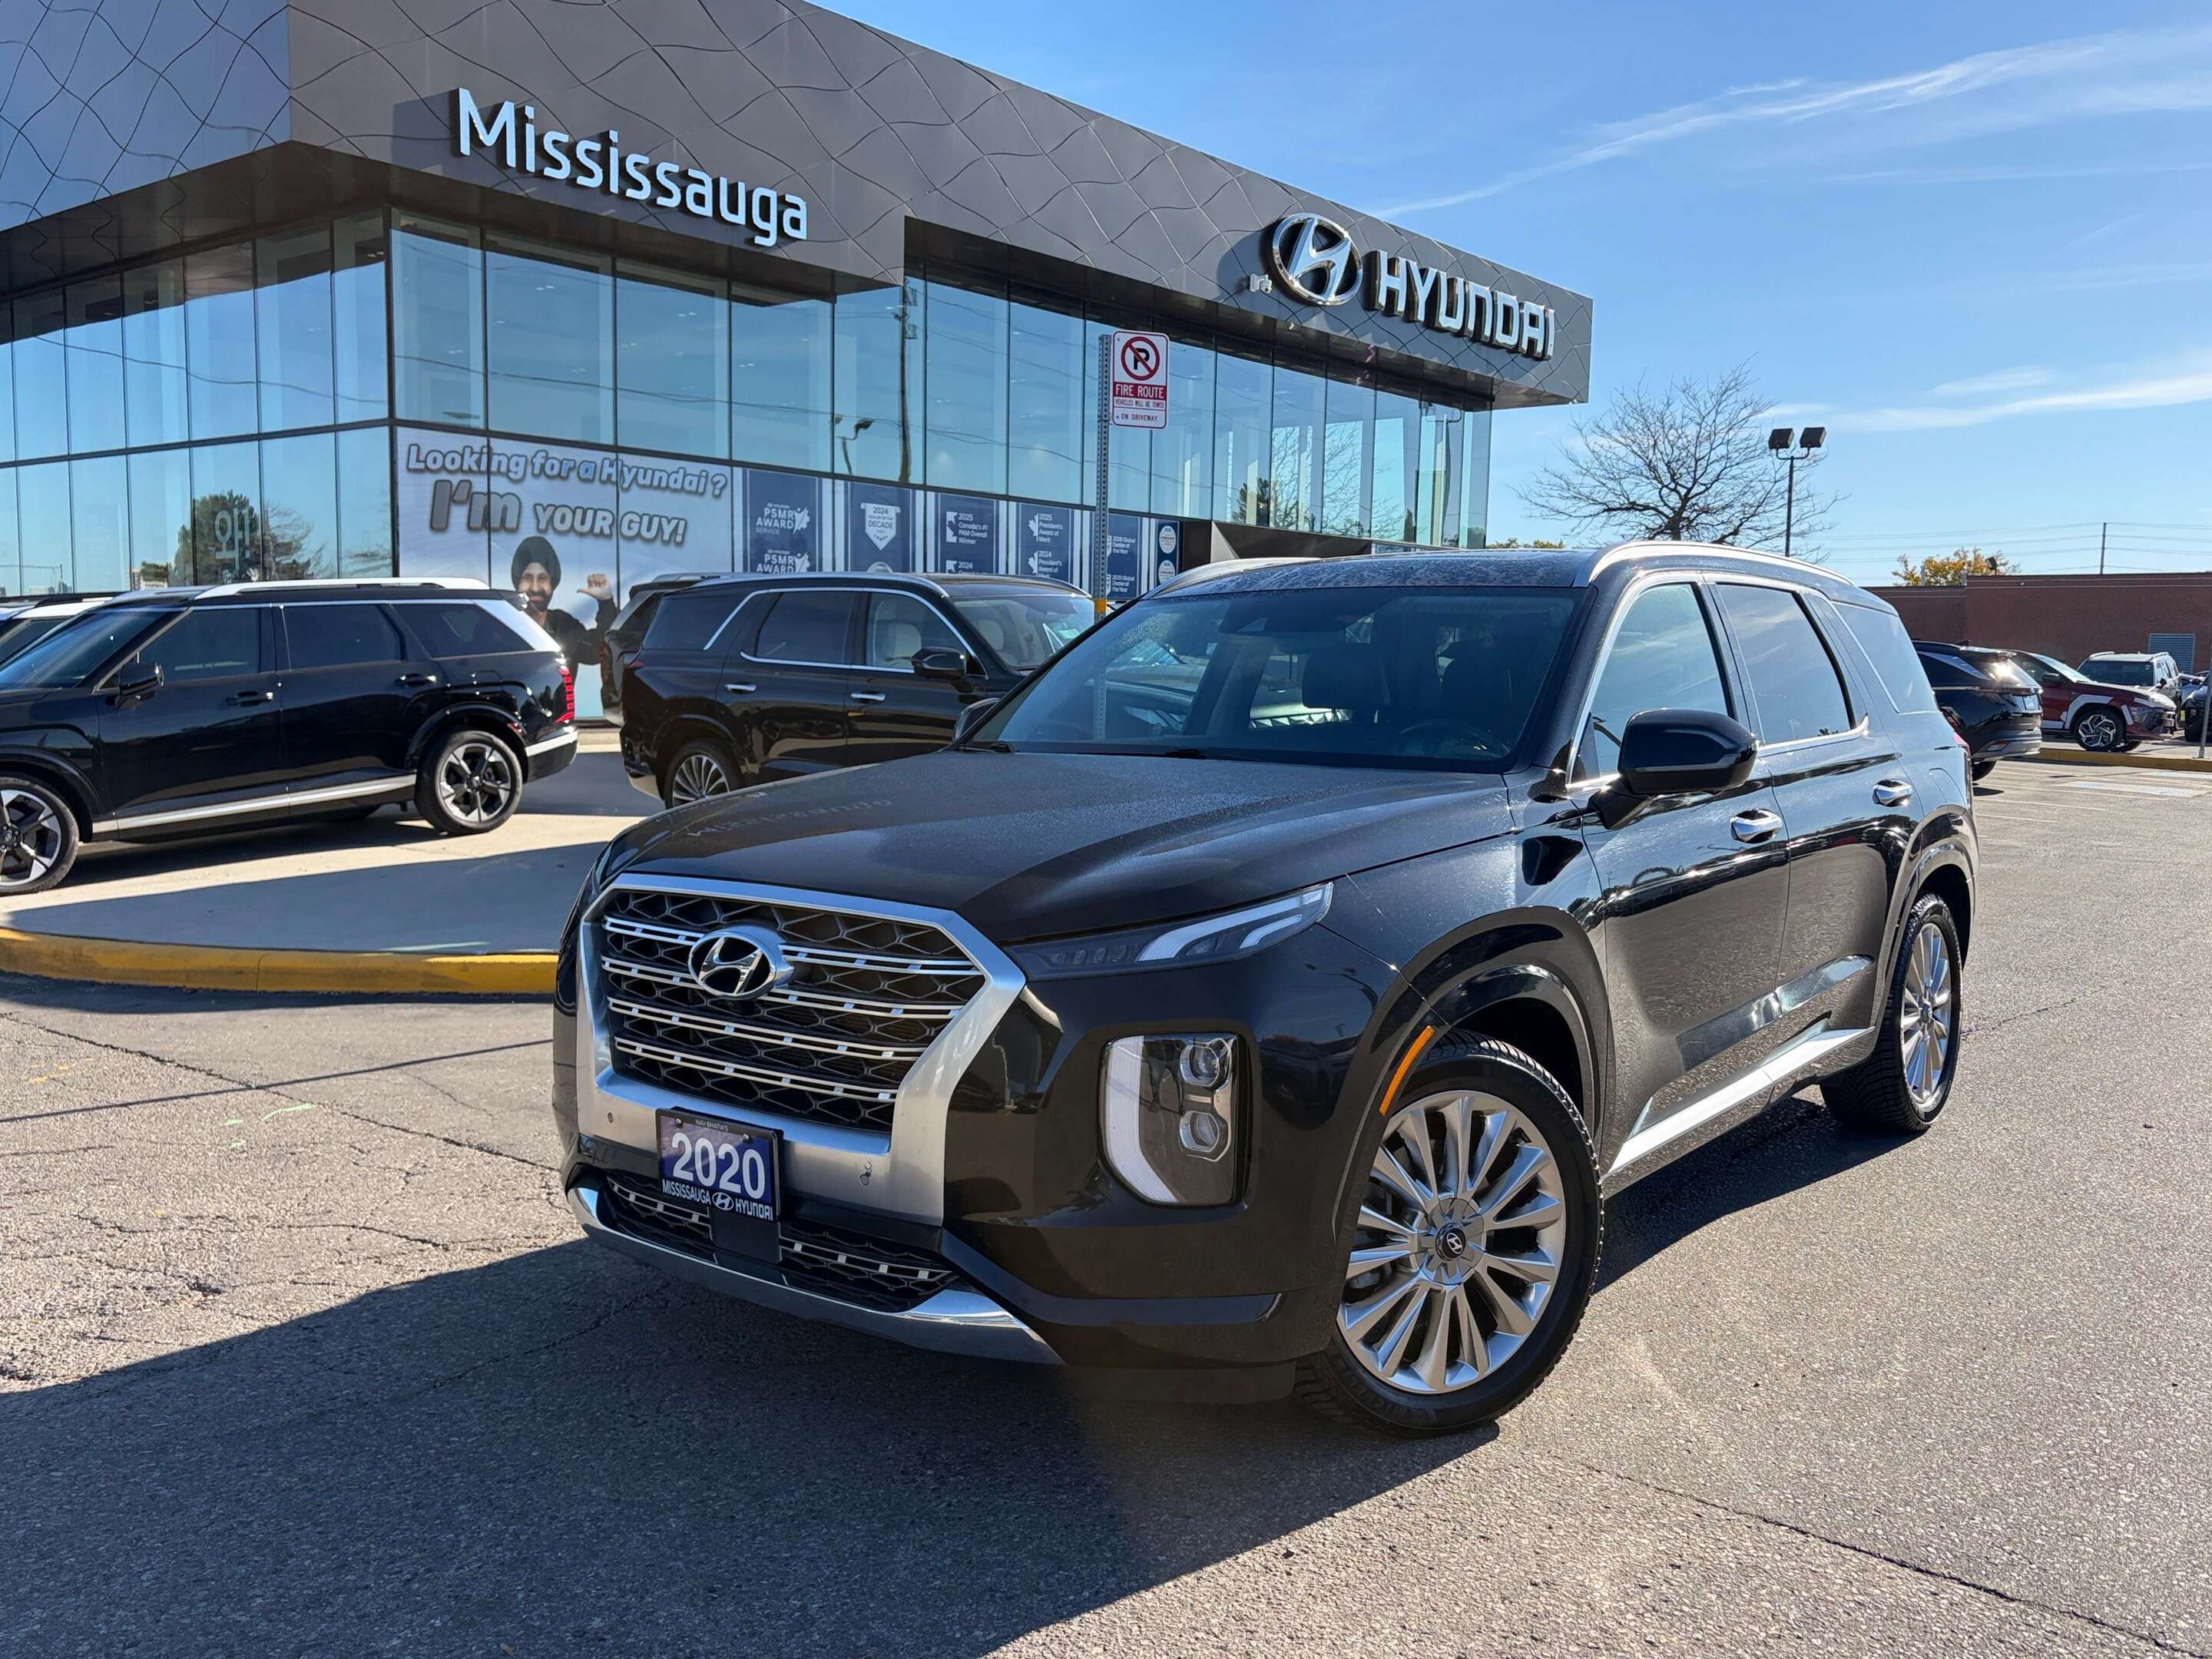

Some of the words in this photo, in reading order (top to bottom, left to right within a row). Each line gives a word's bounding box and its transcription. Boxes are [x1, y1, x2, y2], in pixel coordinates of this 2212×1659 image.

[459, 88, 807, 247] Mississauga
[1377, 250, 1555, 359] HYUNDAI
[1115, 384, 1134, 396] FIRE
[1137, 386, 1164, 399] ROUTE
[406, 443, 527, 482] Looking
[531, 450, 575, 478] for
[578, 460, 595, 482] a
[599, 459, 708, 495] Hyundai
[430, 480, 521, 531] I'm
[534, 503, 614, 536] YOUR
[620, 512, 687, 544] GUY!
[764, 508, 794, 520] PSMR
[959, 512, 974, 522] 2025
[756, 517, 794, 529] AWARD
[868, 520, 893, 529] DECADE
[1038, 522, 1063, 530] President's
[764, 553, 795, 565] PSMR
[756, 563, 794, 574] AWARD
[707, 1121, 729, 1132] BHATIA'S
[671, 1131, 766, 1200] 2020
[662, 1179, 711, 1205] MISSISSAUGA
[735, 1197, 773, 1221] HYUNDAI
